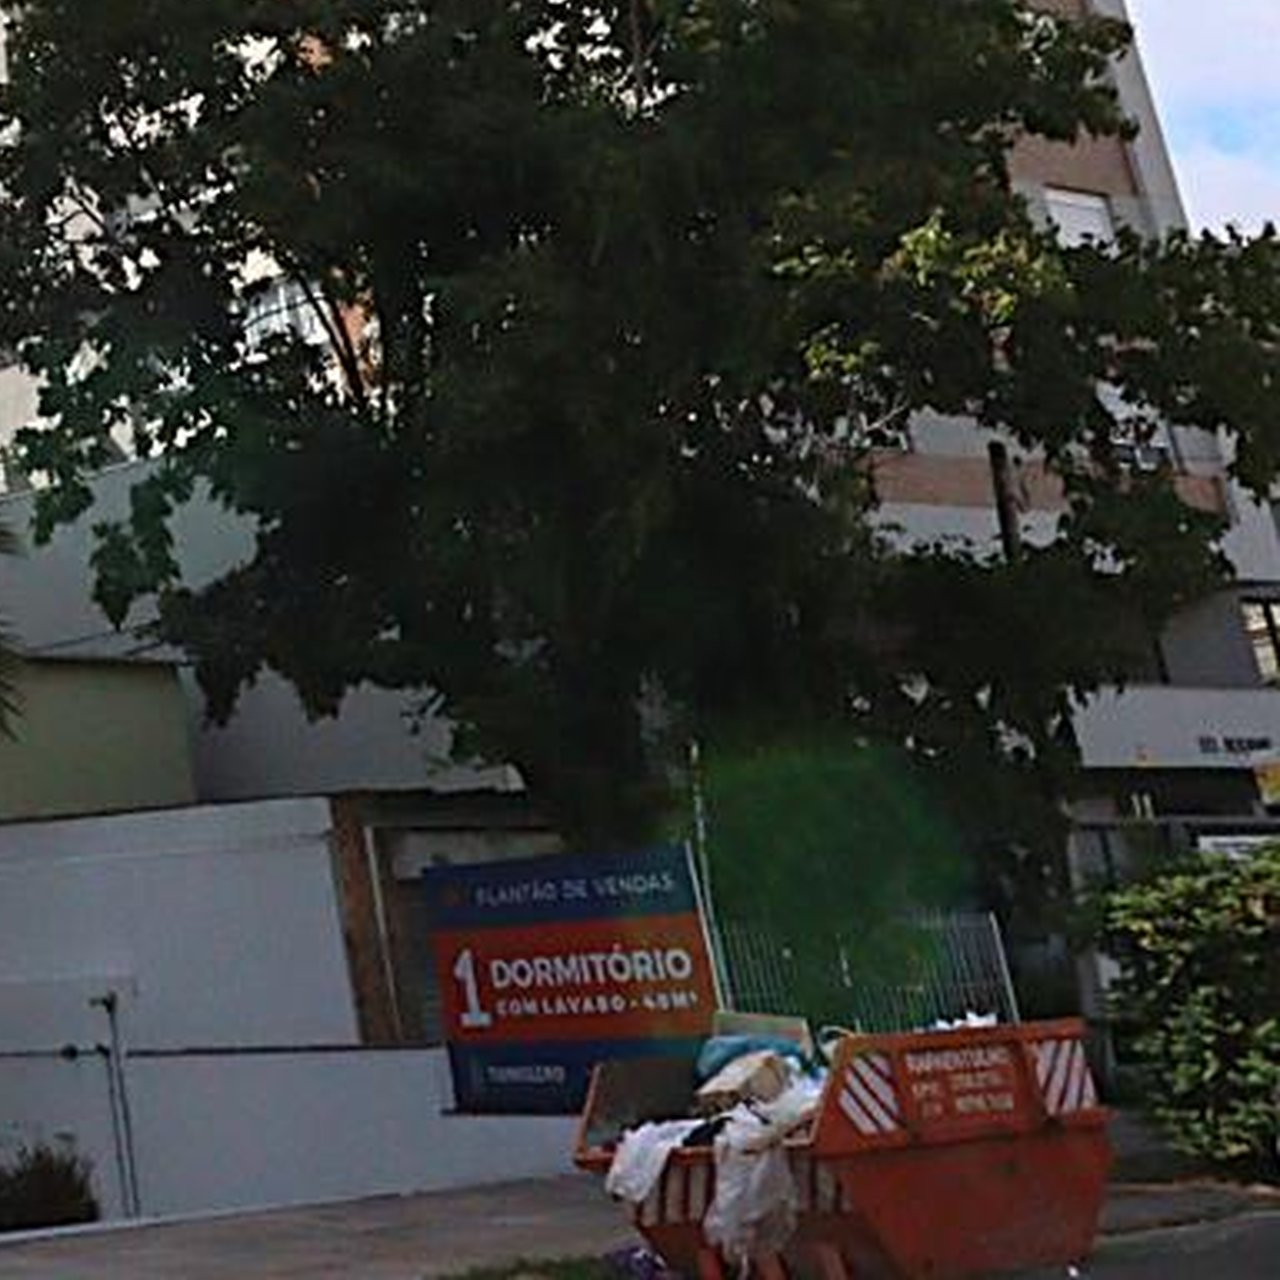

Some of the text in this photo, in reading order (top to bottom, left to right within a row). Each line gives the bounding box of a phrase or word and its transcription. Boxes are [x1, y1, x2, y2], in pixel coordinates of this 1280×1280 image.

[592, 871, 676, 897] VENDAS
[453, 943, 692, 1028] 1 DORMITÓRIO
[542, 993, 627, 1016] LAVABO
